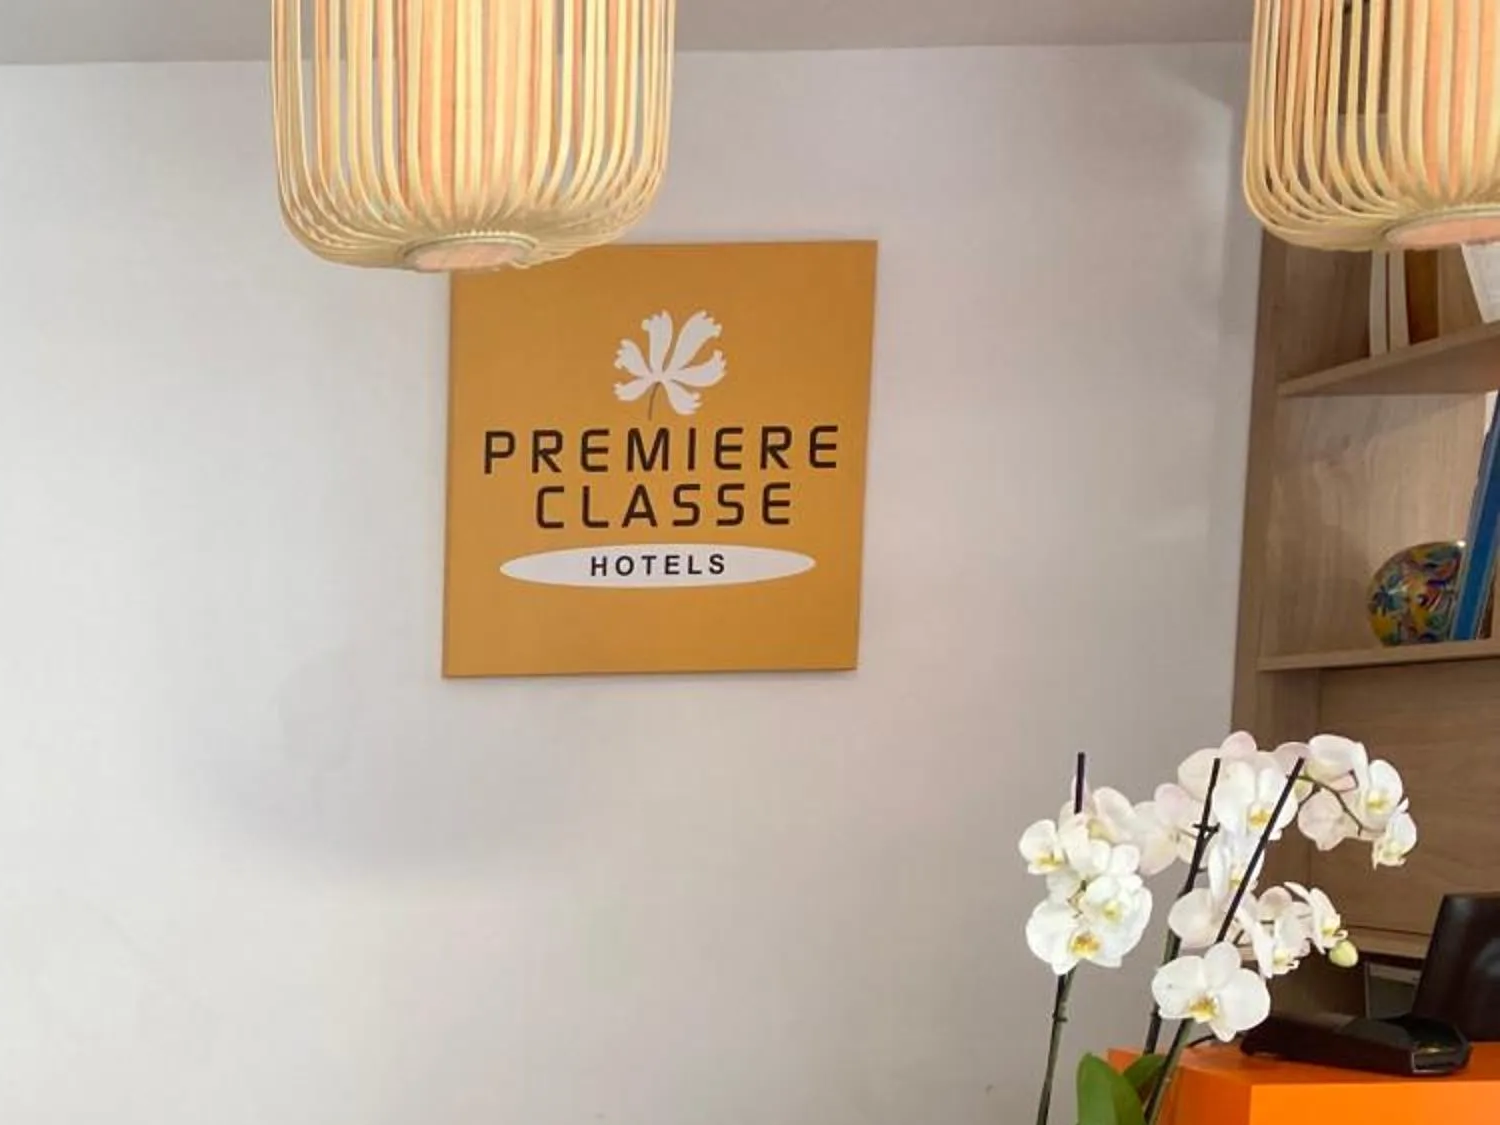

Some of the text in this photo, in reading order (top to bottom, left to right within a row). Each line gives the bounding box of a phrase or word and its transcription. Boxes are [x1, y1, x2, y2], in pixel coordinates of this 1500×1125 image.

[483, 424, 840, 475] PREMIERE
[535, 482, 792, 530] CLASSE
[589, 553, 726, 577] HOTELS
